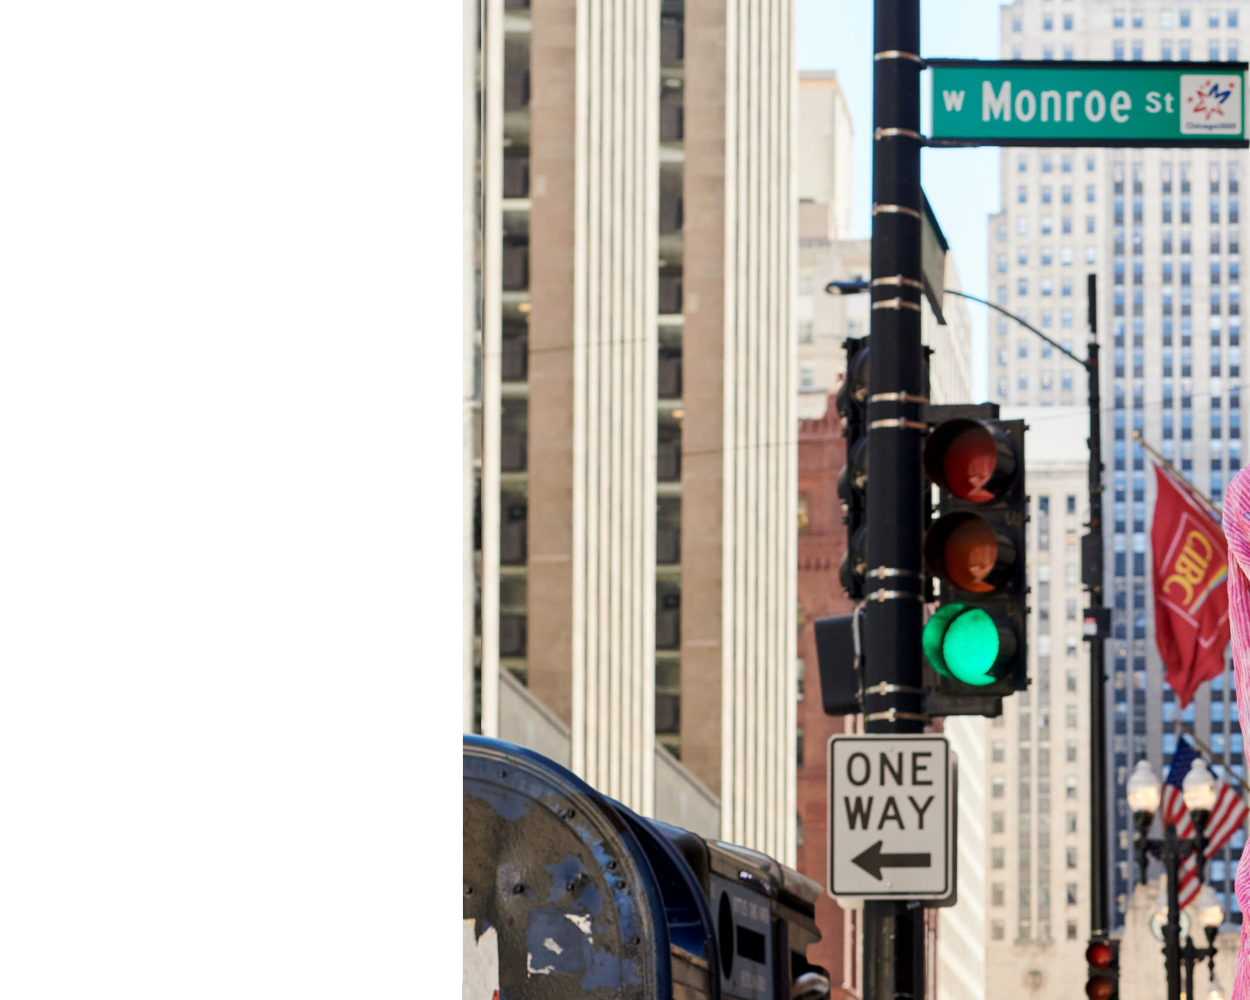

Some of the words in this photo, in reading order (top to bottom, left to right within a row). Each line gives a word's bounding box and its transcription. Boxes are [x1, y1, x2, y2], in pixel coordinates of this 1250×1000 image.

[981, 80, 1133, 123] Monroe
[1144, 91, 1175, 114] St
[846, 752, 933, 786] ONE
[844, 796, 935, 830] WAY
